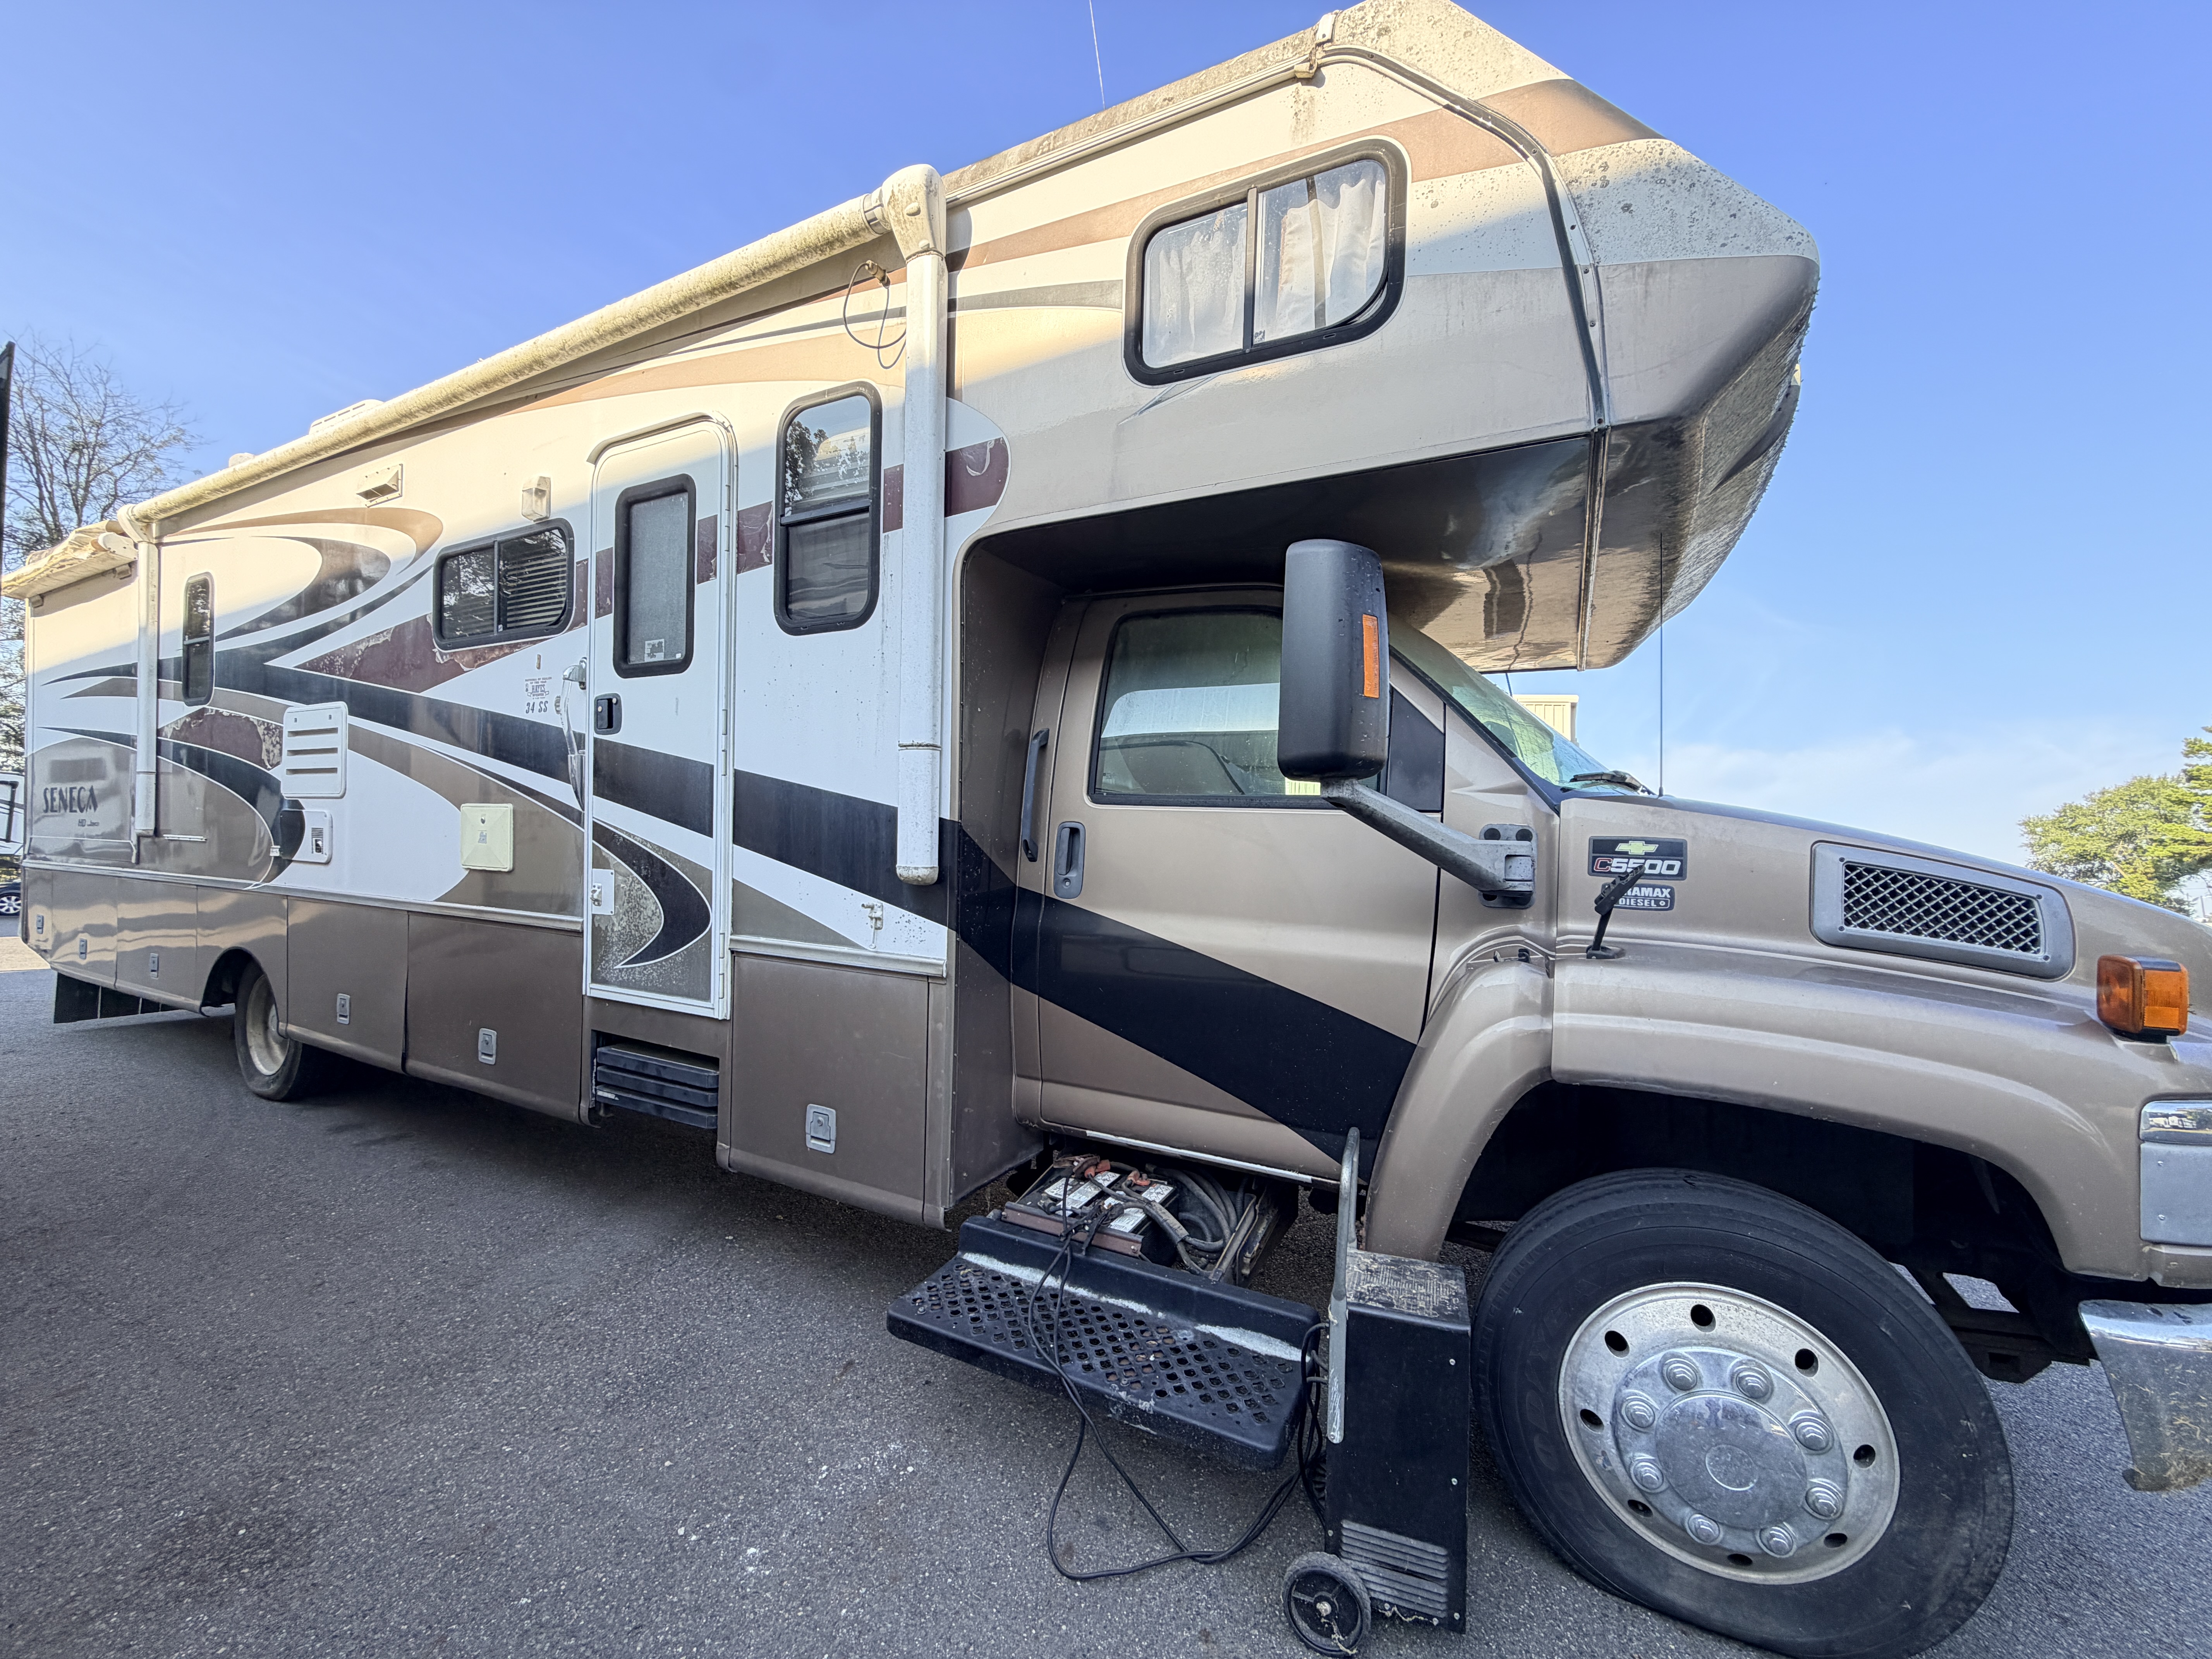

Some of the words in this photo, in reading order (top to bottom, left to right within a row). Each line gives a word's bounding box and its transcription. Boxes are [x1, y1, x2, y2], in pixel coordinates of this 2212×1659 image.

[532, 684, 545, 693] HAYES
[526, 702, 535, 713] 34
[538, 701, 548, 713] SS
[43, 785, 98, 813] SENECA
[1594, 857, 1681, 874] C5500
[1619, 898, 1657, 907] DIESEL
